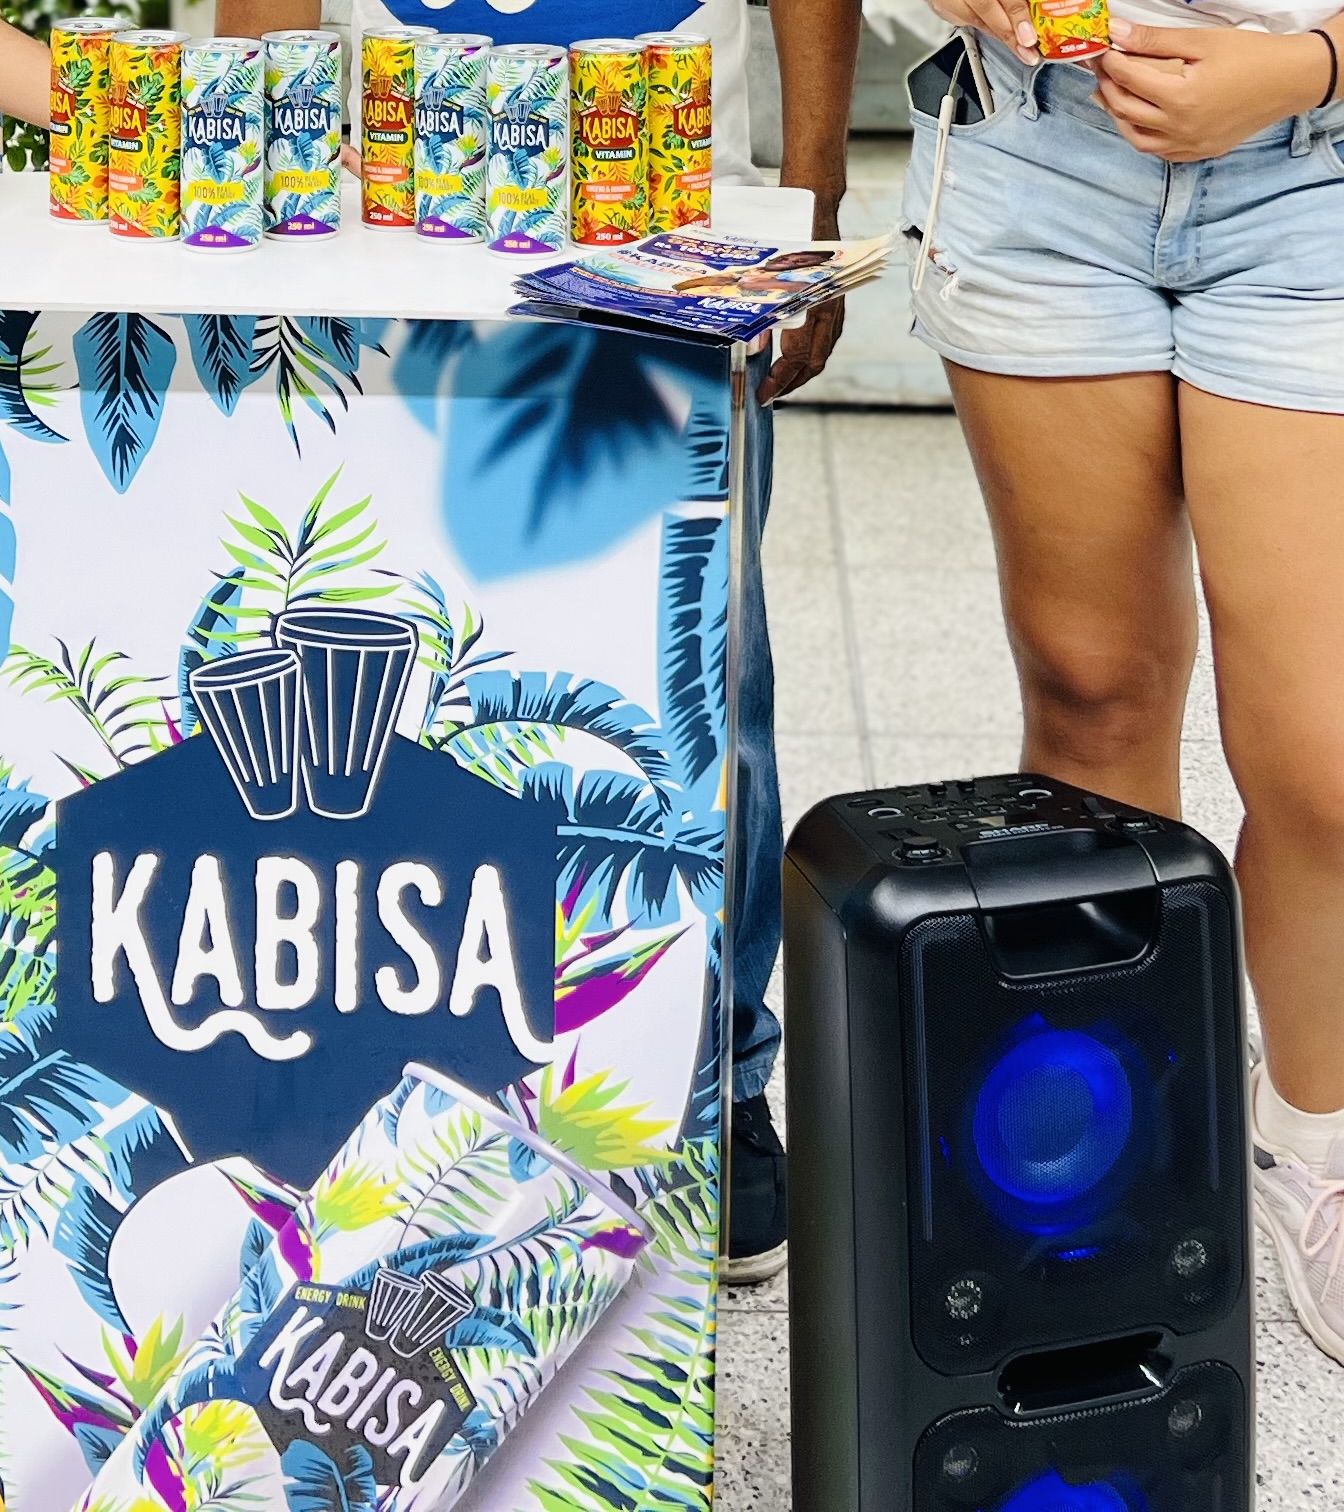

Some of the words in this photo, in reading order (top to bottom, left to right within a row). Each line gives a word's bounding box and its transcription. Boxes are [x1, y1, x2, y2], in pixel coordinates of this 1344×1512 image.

[188, 115, 244, 146] KABISA
[274, 107, 330, 136] KABISA
[583, 116, 638, 145] KABISA
[678, 104, 711, 136] KABIS
[369, 131, 404, 142] VITAMIN
[493, 122, 549, 151] KABISA
[594, 149, 634, 160] VITAMIN
[90, 851, 555, 1062] KABISA
[294, 1286, 332, 1304] ENERGY
[336, 1292, 367, 1311] DRINK
[429, 1346, 456, 1384] ENERGY
[259, 1306, 446, 1487] KABISA
